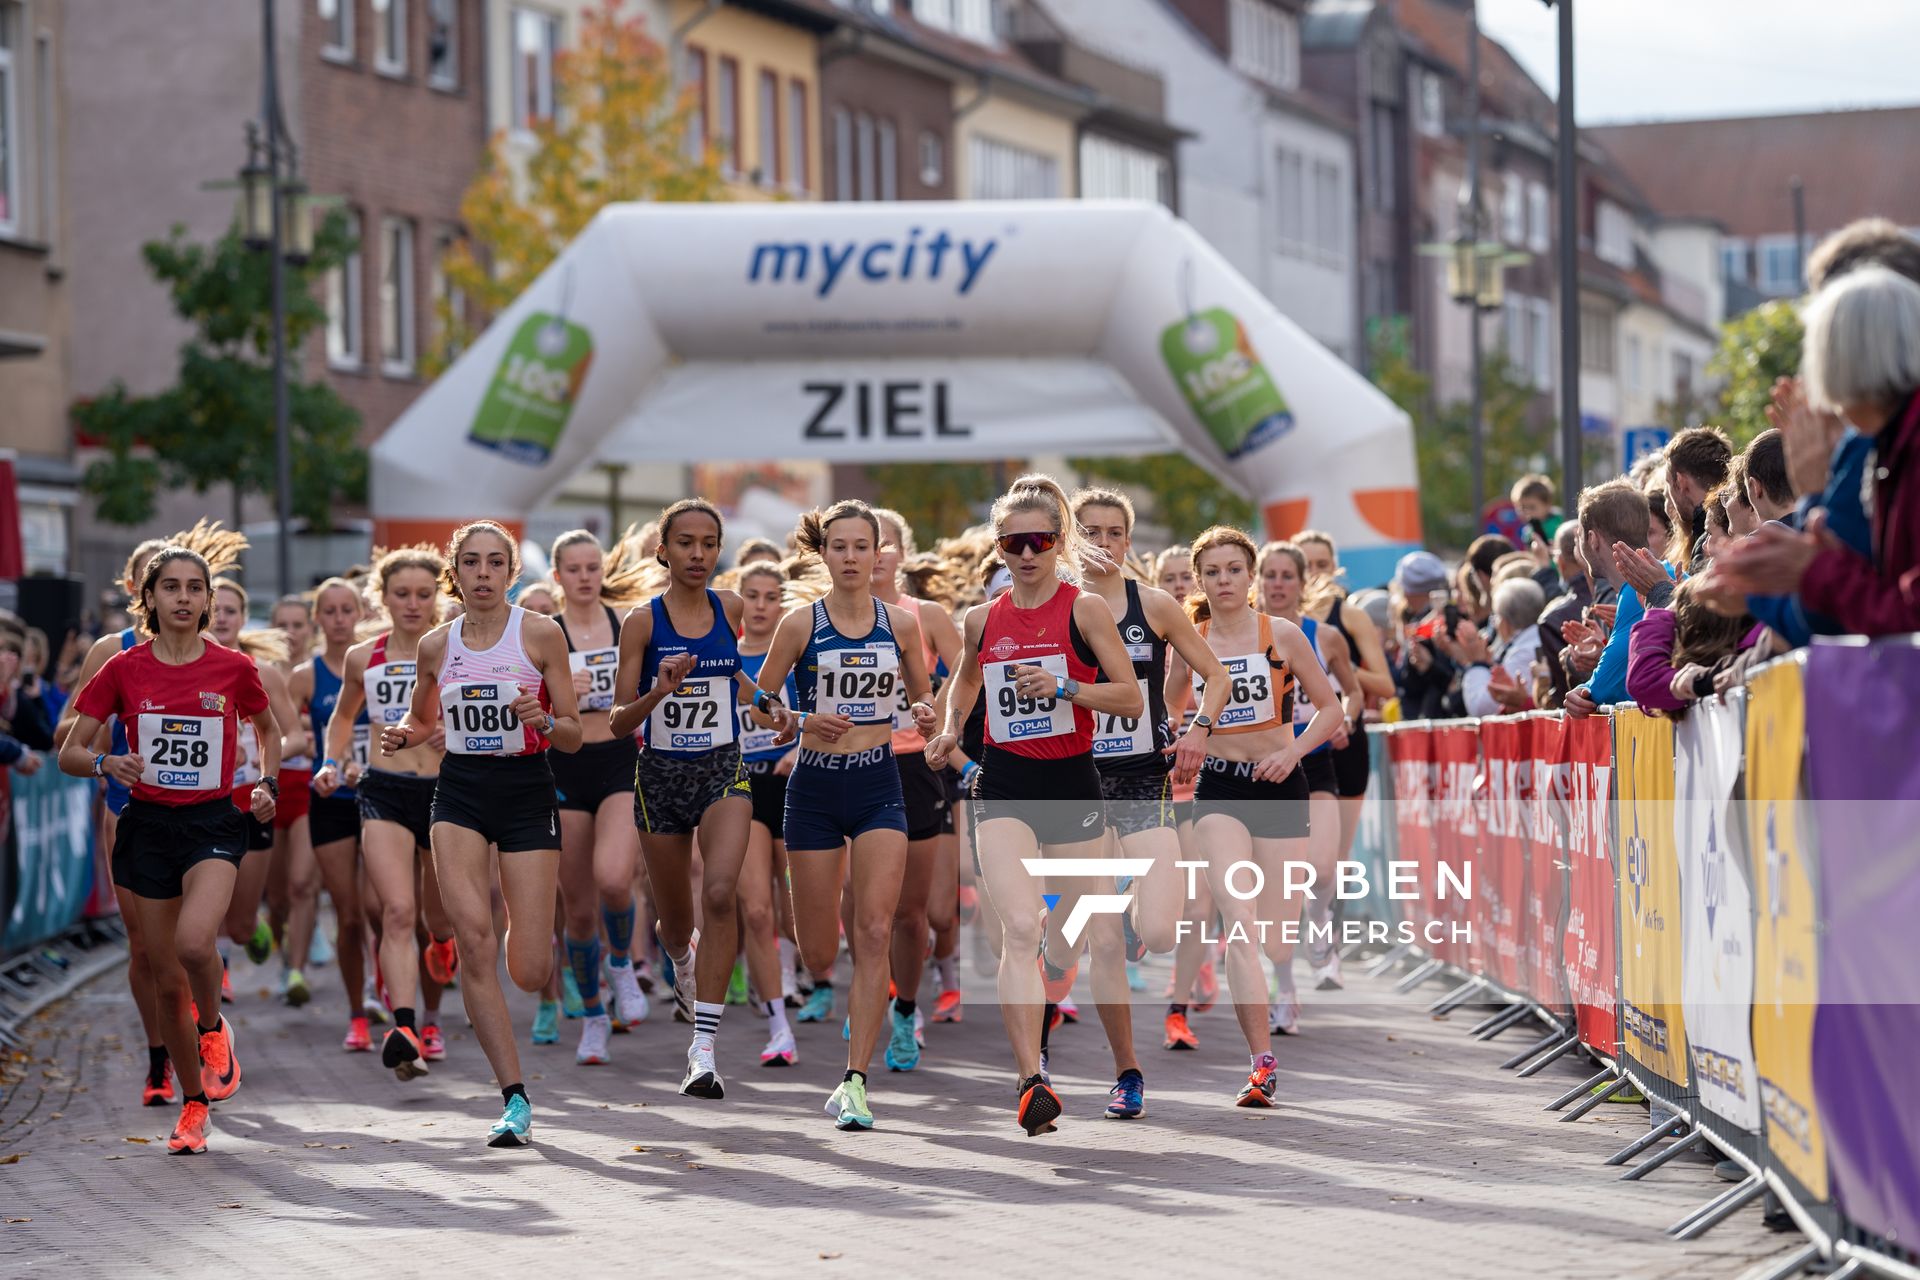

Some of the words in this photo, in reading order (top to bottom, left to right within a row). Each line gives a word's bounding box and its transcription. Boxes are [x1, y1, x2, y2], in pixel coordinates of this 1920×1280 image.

[749, 227, 997, 298] mycity
[803, 380, 972, 439] ZIEL
[700, 658, 735, 668] FINANZ
[860, 656, 875, 665] GLS
[1229, 662, 1245, 672] GLS
[692, 685, 707, 694] GLS
[822, 671, 895, 699] 1029
[376, 680, 416, 705] 97
[480, 688, 495, 698] GLS
[447, 704, 519, 733] 1080
[663, 700, 719, 729] 972
[1232, 709, 1254, 718] PLAN
[182, 724, 198, 733] GLS
[1025, 720, 1050, 730] PLAN
[480, 739, 501, 747] PLAN
[687, 735, 710, 743] PLAN
[1108, 739, 1131, 748] PLAN
[151, 737, 209, 768] 258
[800, 747, 842, 770] NIKE
[844, 746, 884, 770] PRO
[1204, 755, 1228, 773] RO
[174, 773, 198, 782] PLAN
